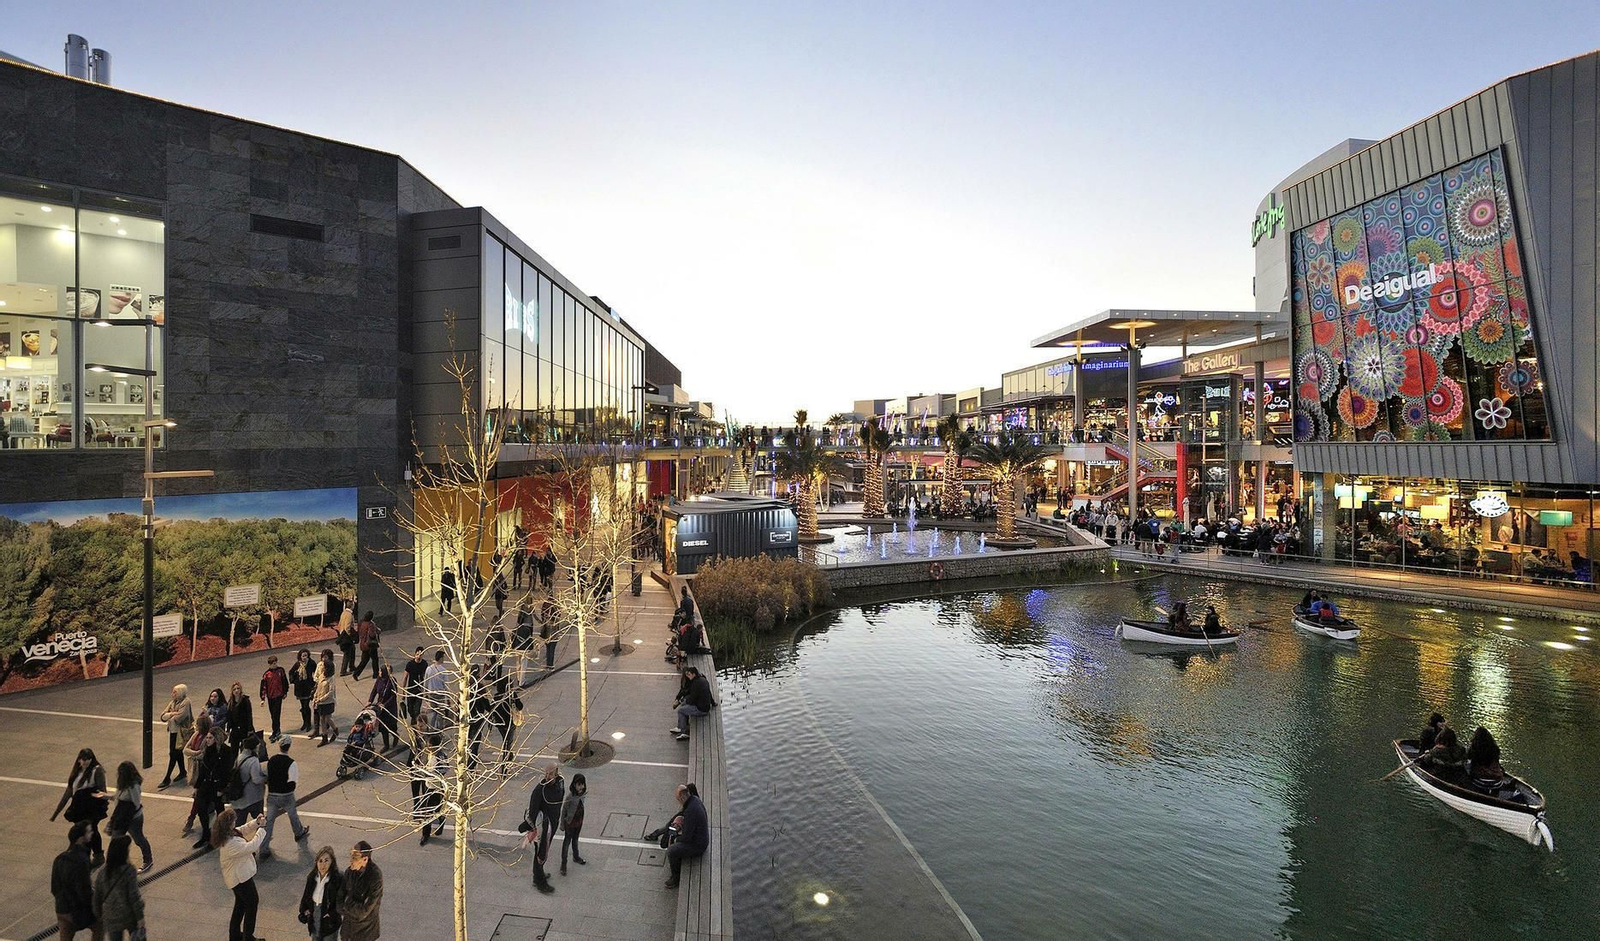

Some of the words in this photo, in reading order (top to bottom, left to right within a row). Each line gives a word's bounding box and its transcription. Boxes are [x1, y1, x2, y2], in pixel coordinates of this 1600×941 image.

[1344, 262, 1437, 305] Desigual
[1183, 359, 1199, 374] The
[1201, 353, 1238, 371] Gallery
[54, 630, 88, 642] Puerto
[21, 636, 97, 658] venecia
